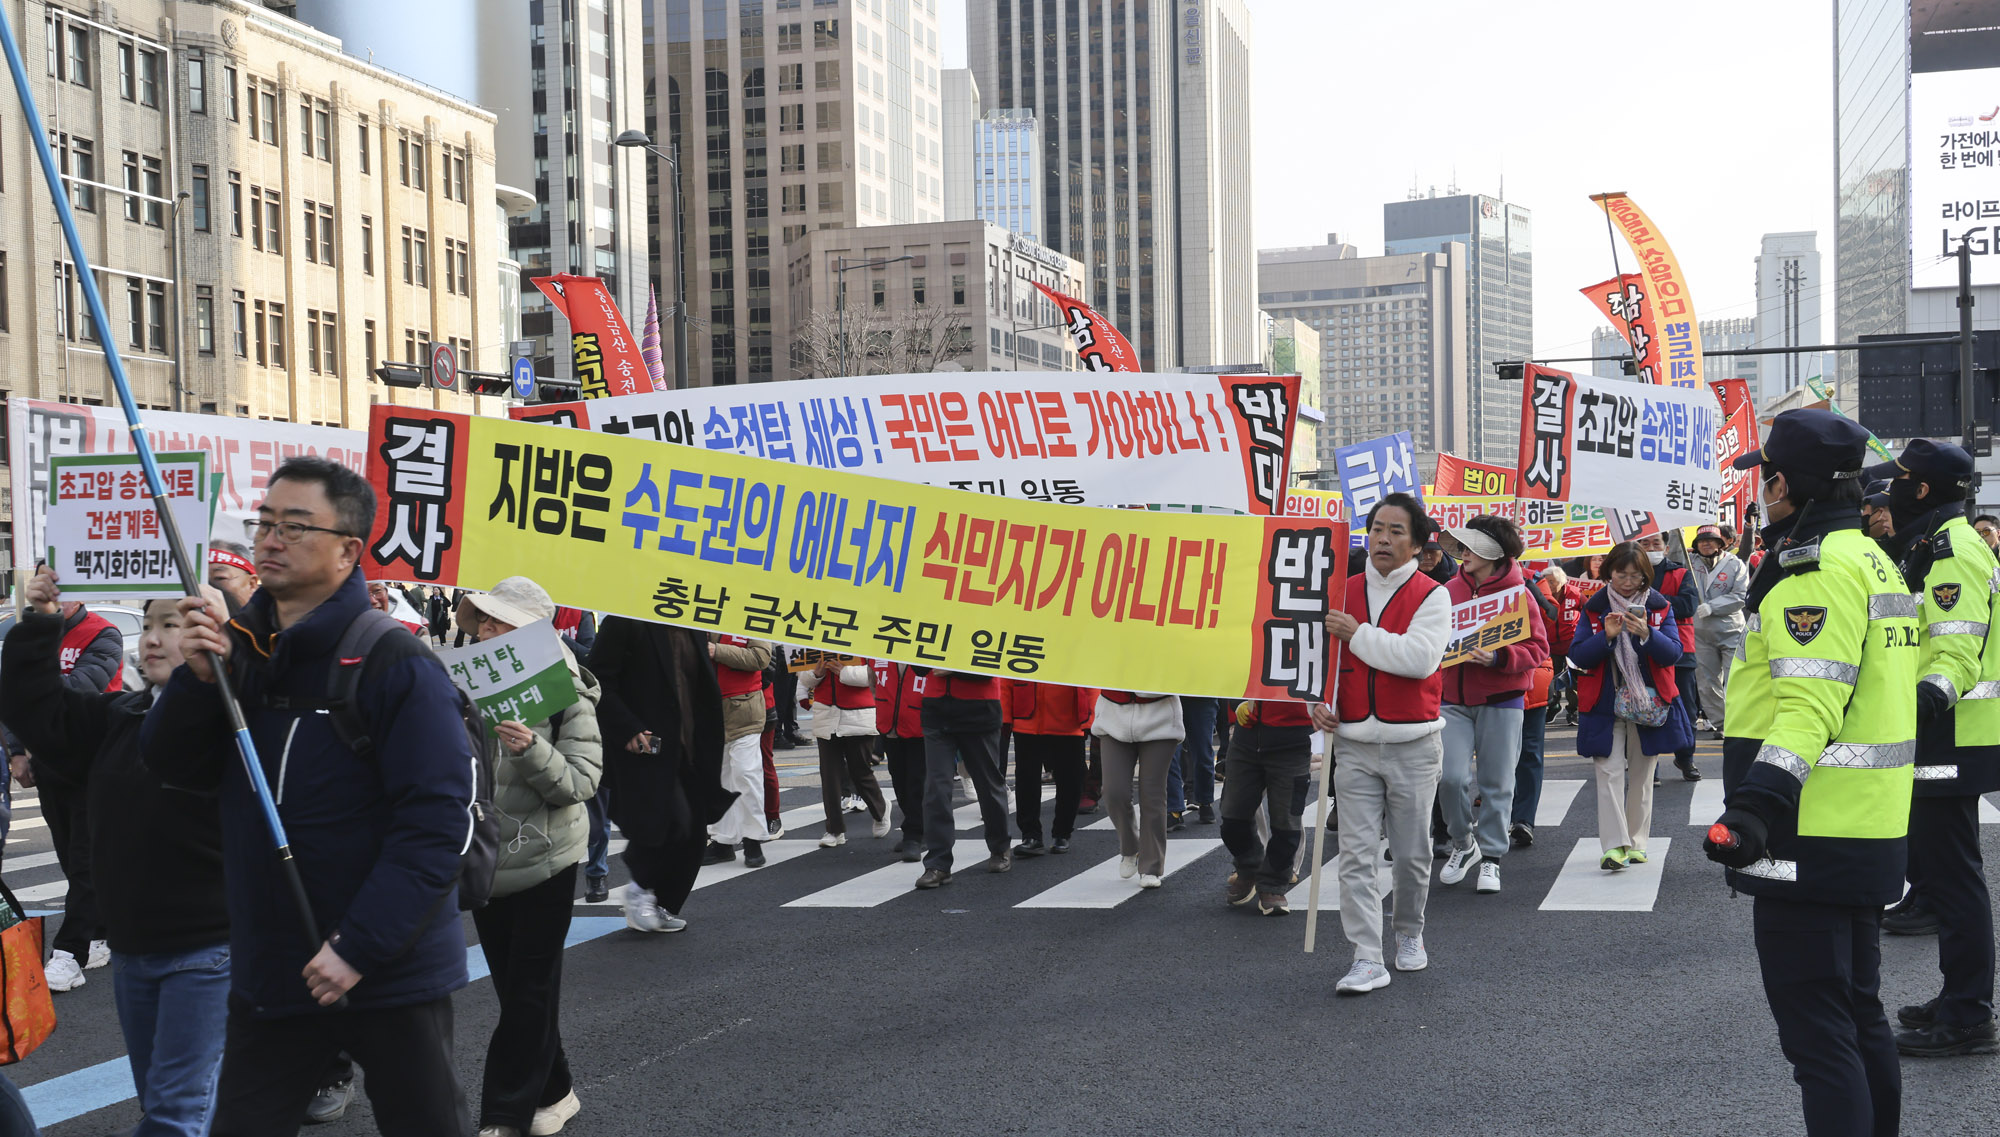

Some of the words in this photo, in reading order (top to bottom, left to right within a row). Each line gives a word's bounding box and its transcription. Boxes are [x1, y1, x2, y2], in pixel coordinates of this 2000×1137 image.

[1183, 0, 1200, 64] 울신문
[1940, 152, 1957, 169] 한
[1961, 150, 1993, 168] 번에
[880, 391, 979, 463] 국민은
[980, 390, 1077, 460] 어디로
[1526, 377, 1567, 496] 결사
[1577, 389, 1637, 459] 초고압
[1640, 398, 1688, 465] 송전탑
[59, 471, 115, 500] 초고압
[377, 418, 454, 578] 결사
[1463, 467, 1506, 495] 법이
[1665, 480, 1696, 512] 충남
[86, 508, 160, 540] 건설계획
[489, 443, 612, 543] 지방은
[621, 462, 785, 572] 수도권의
[788, 490, 916, 593] 에너지
[922, 511, 1087, 617] 식민지가
[1090, 532, 1228, 630] 아니다!
[74, 549, 173, 580] 백지화하라!
[652, 577, 730, 625] 충남
[744, 592, 859, 646] 금산군
[873, 614, 952, 662] 주민
[970, 629, 1046, 674] 일동
[1265, 531, 1333, 697] 반대
